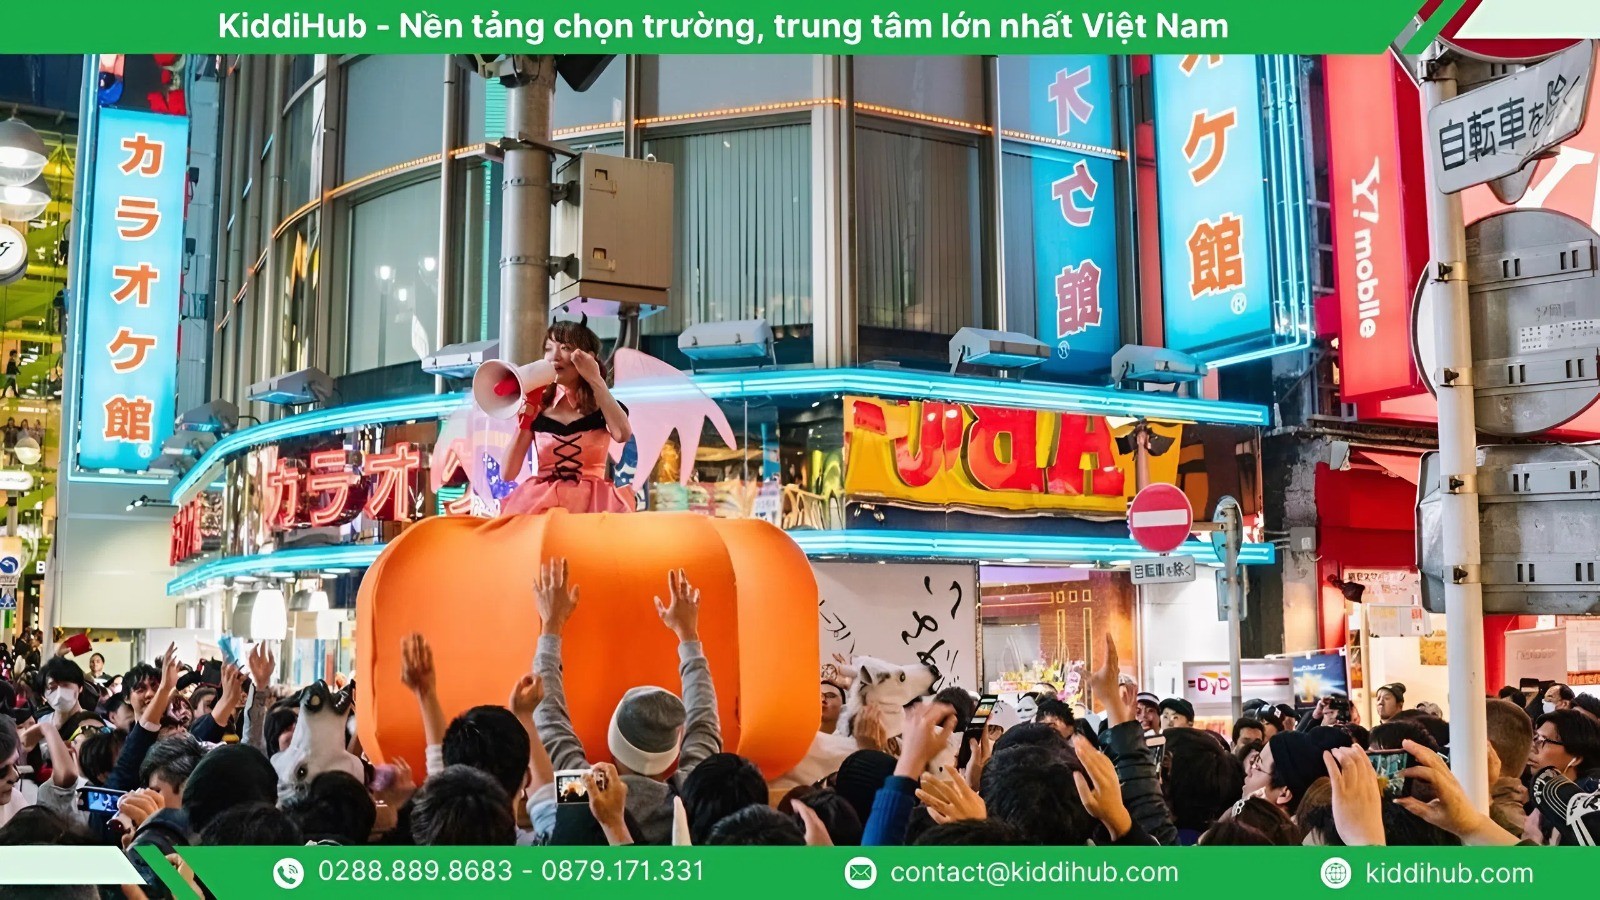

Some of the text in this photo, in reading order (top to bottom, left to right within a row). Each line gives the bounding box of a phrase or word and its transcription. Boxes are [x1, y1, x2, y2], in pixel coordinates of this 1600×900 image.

[103, 132, 165, 444] カラオケ館
[1353, 228, 1382, 340] mobile
[1197, 677, 1231, 695] DyD
